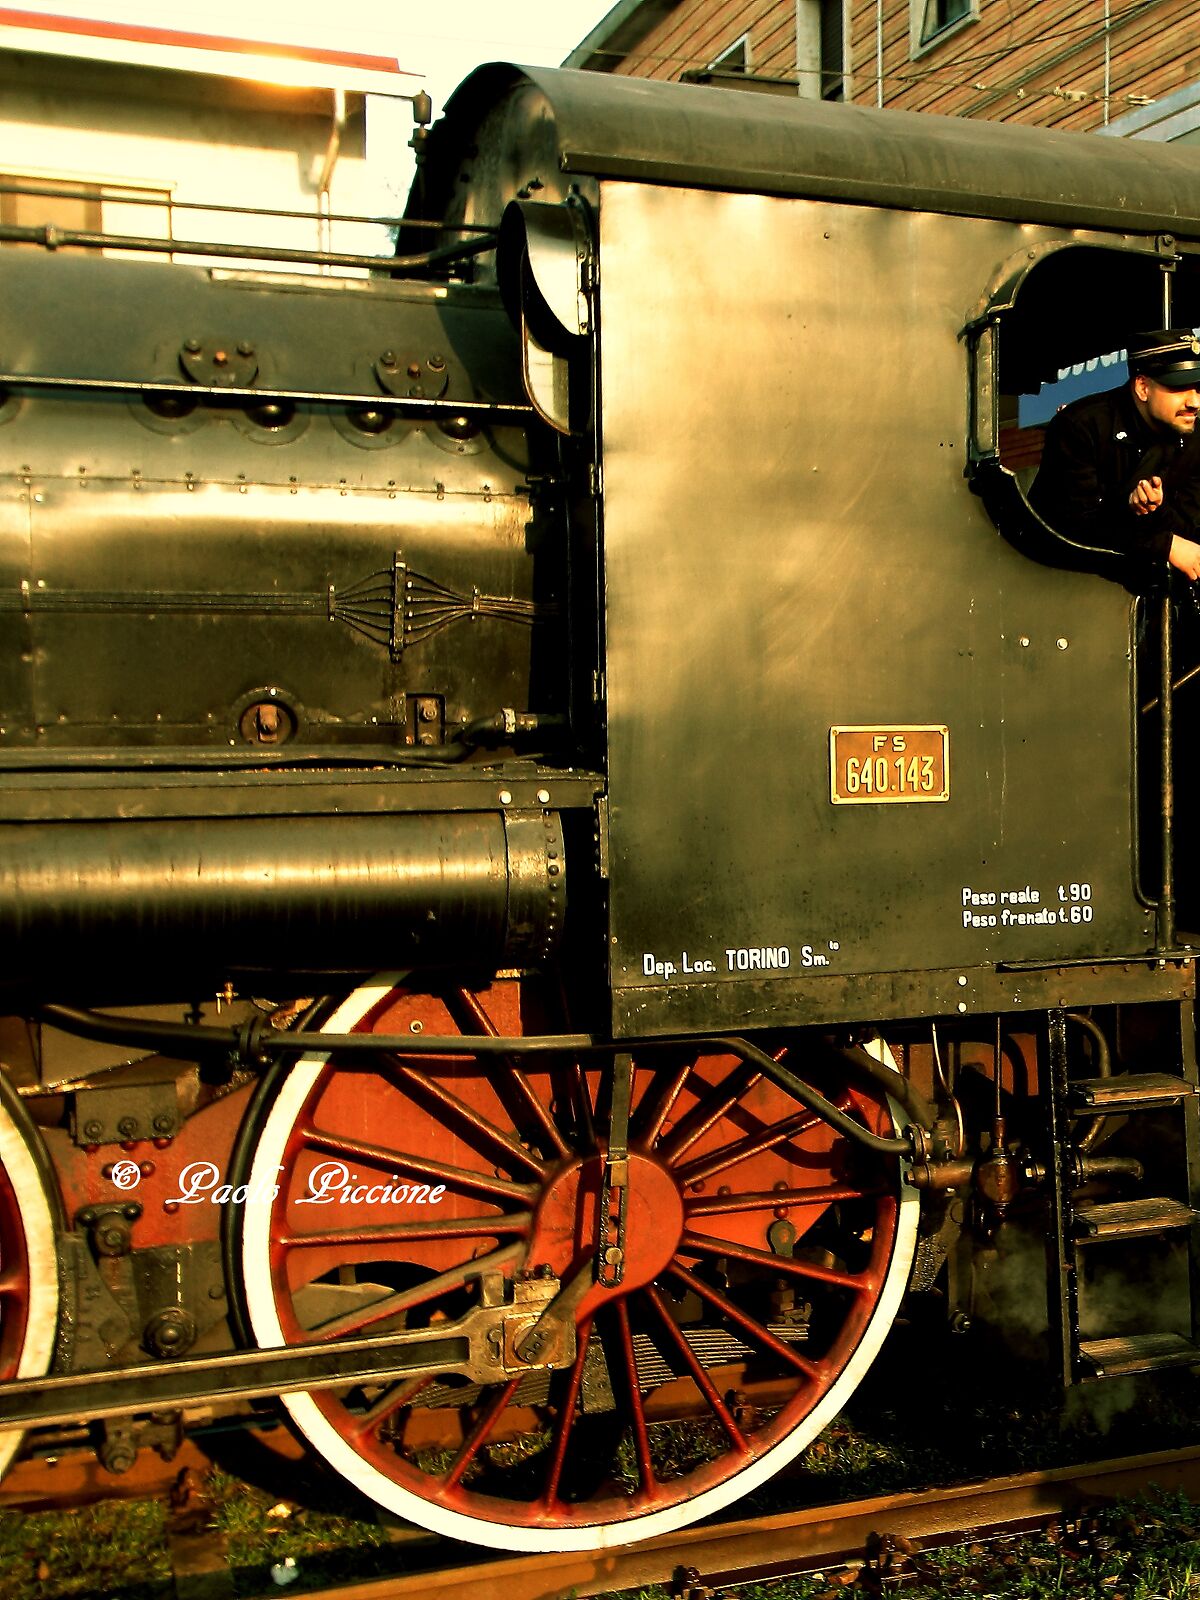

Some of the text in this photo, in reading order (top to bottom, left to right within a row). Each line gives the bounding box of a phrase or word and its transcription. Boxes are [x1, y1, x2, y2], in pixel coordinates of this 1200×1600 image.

[846, 755, 935, 793] 640.143
[962, 887, 996, 906] Peso
[1000, 885, 1040, 904] reale
[962, 910, 997, 928] Peso
[1000, 908, 1057, 926] frenato
[643, 953, 677, 980] Dep.
[682, 951, 717, 974] Loc.
[725, 946, 790, 971] TORINO
